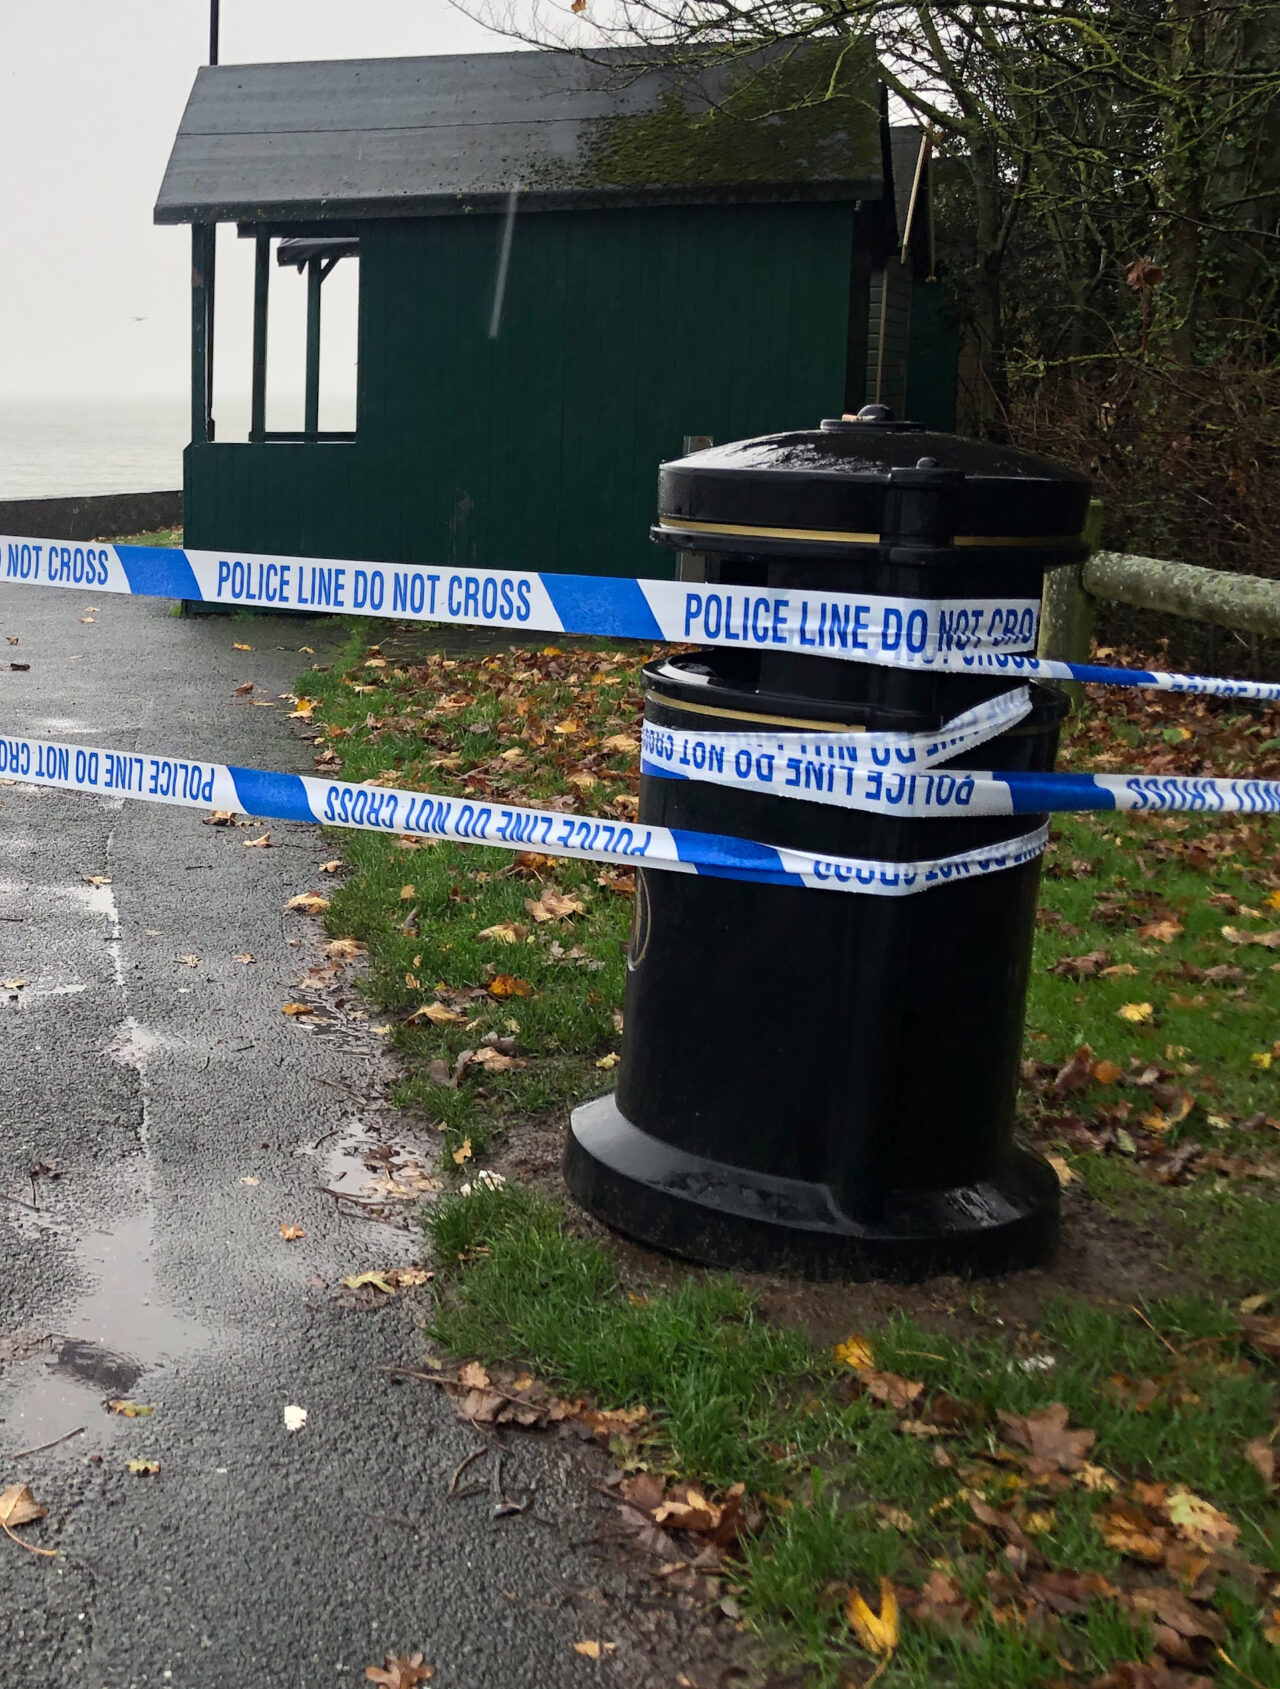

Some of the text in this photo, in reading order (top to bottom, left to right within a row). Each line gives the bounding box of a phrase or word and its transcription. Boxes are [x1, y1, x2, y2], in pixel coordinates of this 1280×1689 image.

[7, 543, 42, 579] NOT
[48, 546, 109, 586] CROSS
[217, 560, 531, 622] POLICE LINE DO NOT CROSS
[684, 592, 789, 645] POLICE
[799, 601, 871, 650] LINE
[882, 607, 927, 653] DO
[938, 609, 984, 652] NOT
[35, 745, 69, 781] NOT
[75, 749, 99, 785] DO
[104, 754, 144, 792] LINE
[679, 739, 725, 773] NOT
[735, 749, 775, 782] DO
[149, 760, 215, 802] POLICE
[785, 757, 855, 796] LINE
[865, 769, 975, 806] POLICE
[1126, 778, 1224, 811] CROSS
[324, 785, 652, 857] POLICE LINE DO NOT CROSS
